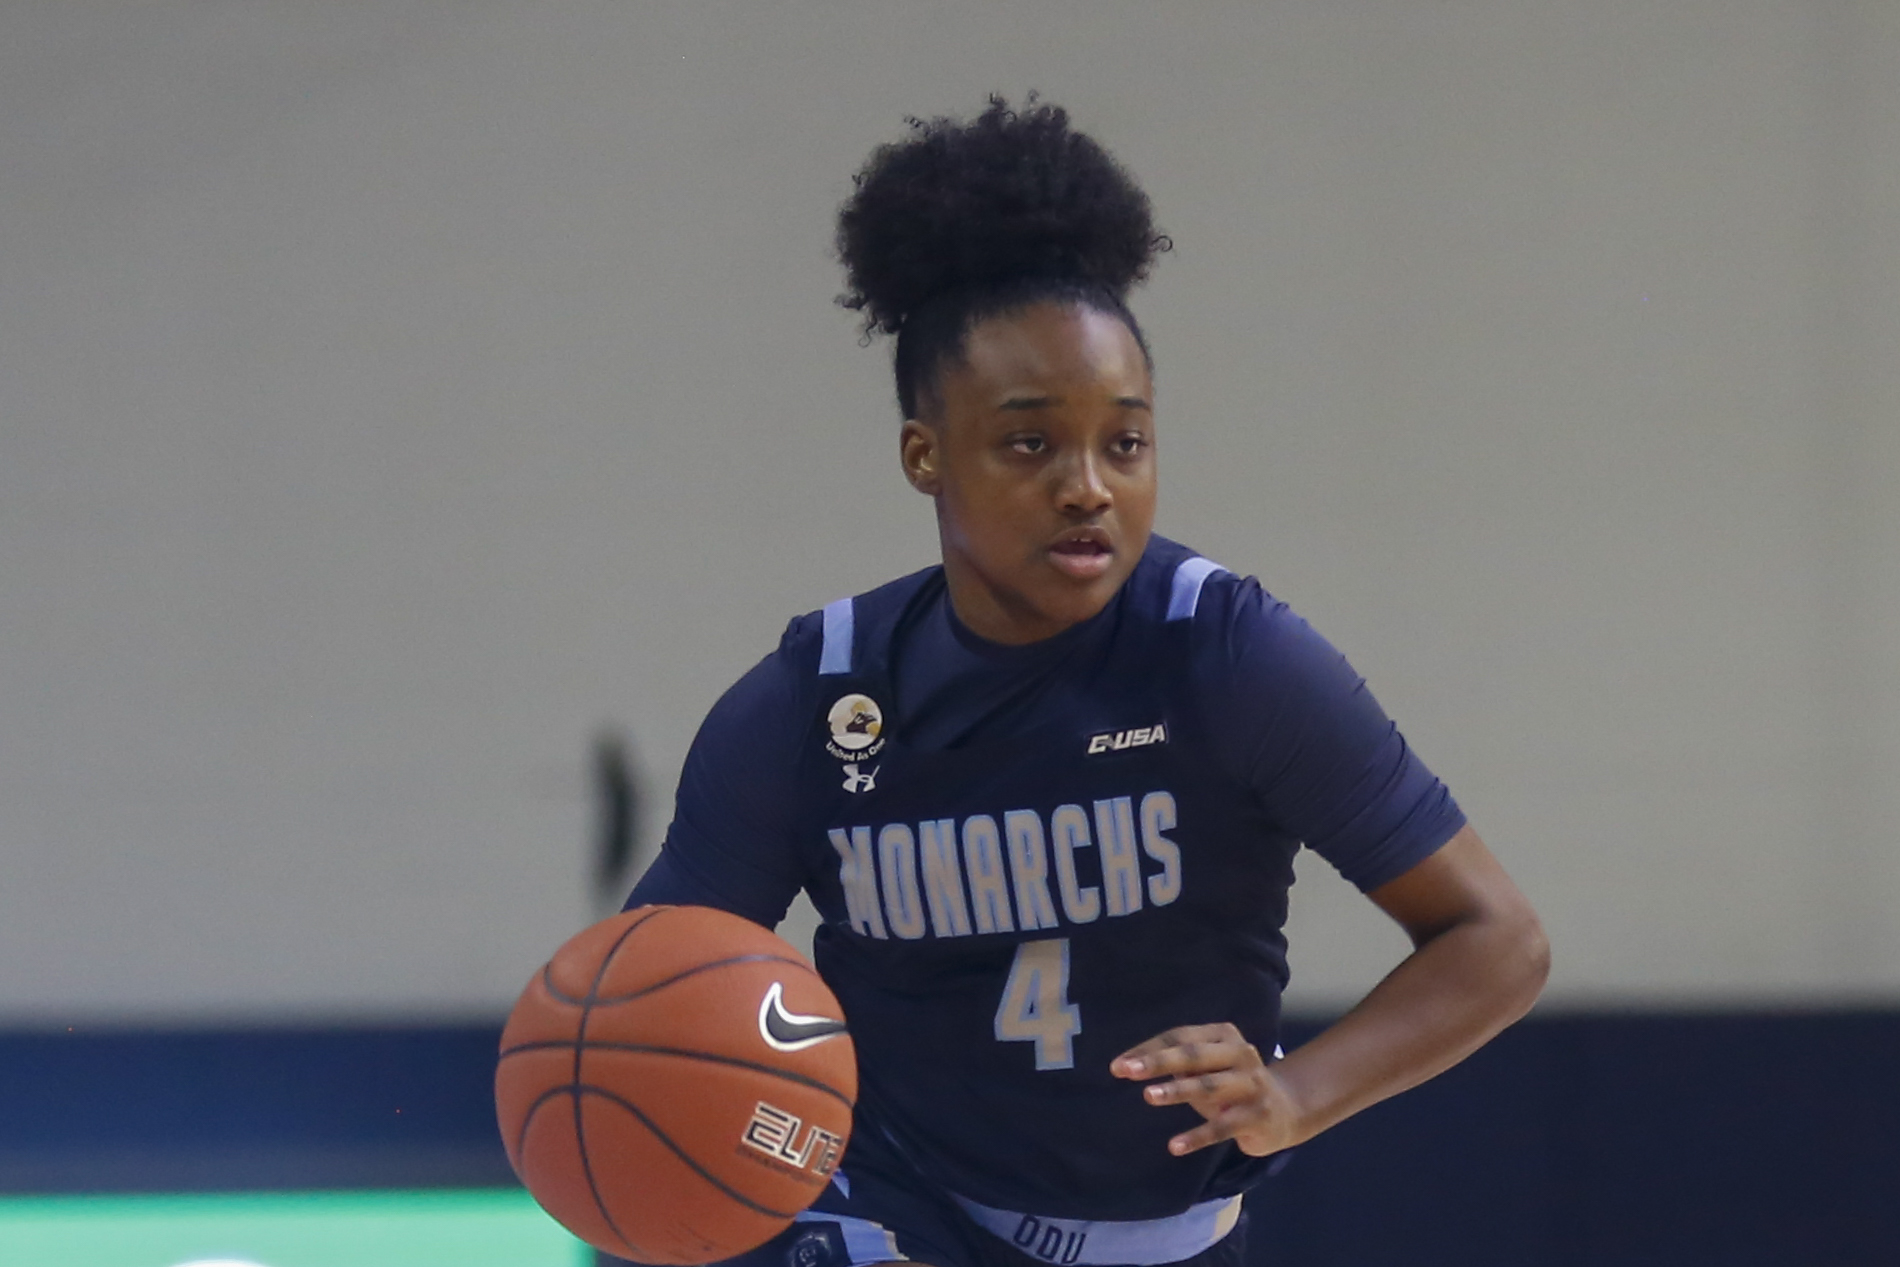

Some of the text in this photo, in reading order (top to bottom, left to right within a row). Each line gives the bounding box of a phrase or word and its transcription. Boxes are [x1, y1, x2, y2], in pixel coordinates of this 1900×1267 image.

[827, 790, 1182, 940] MONARCHS
[994, 938, 1082, 1072] 4
[741, 1101, 843, 1176] ELITE
[1013, 1215, 1087, 1265] ODU
